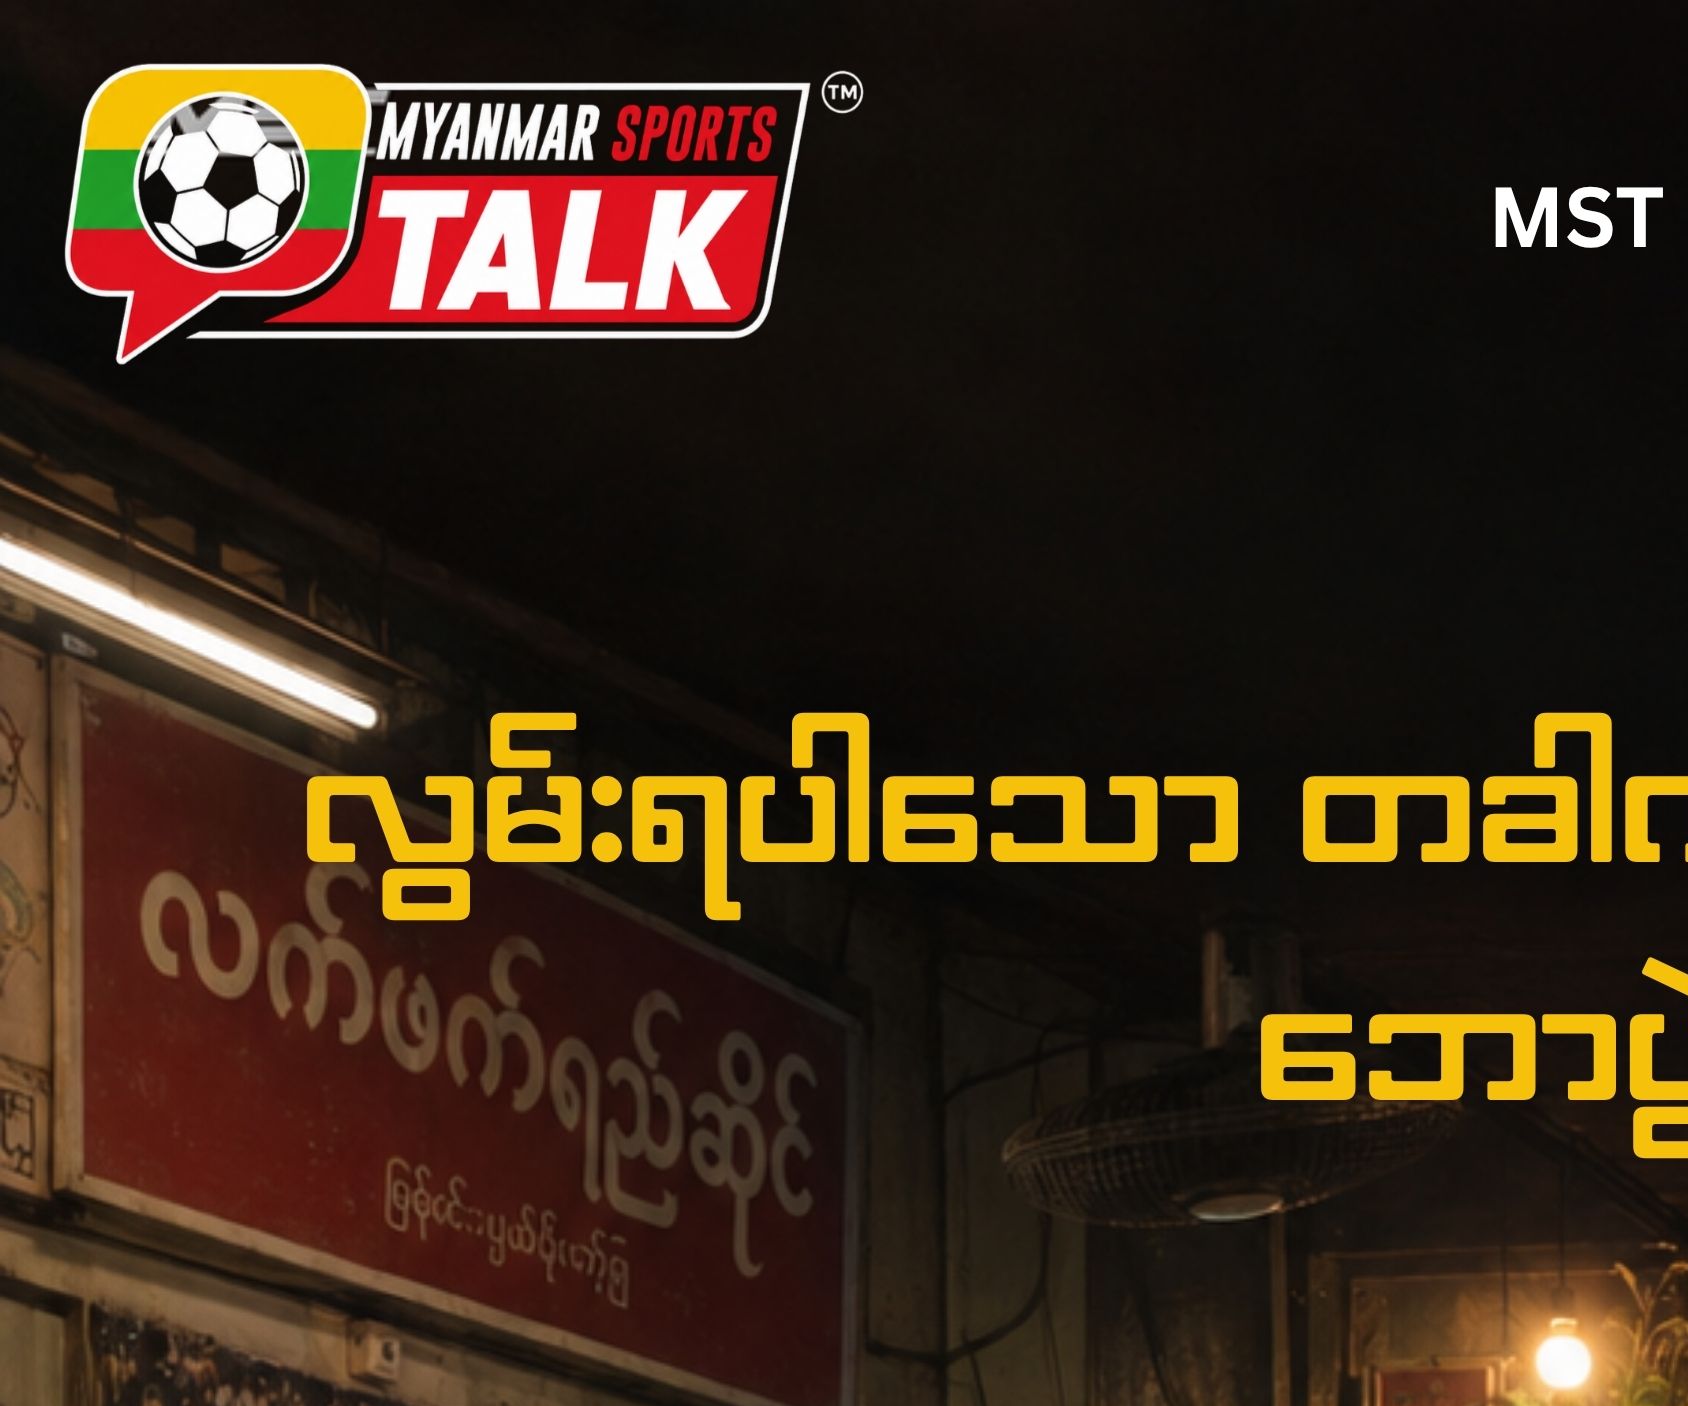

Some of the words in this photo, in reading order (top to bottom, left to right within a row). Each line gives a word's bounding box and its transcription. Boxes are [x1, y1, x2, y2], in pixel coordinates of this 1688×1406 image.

[141, 862, 818, 1279] လက်ဖက်ရည်ဆိုင်
